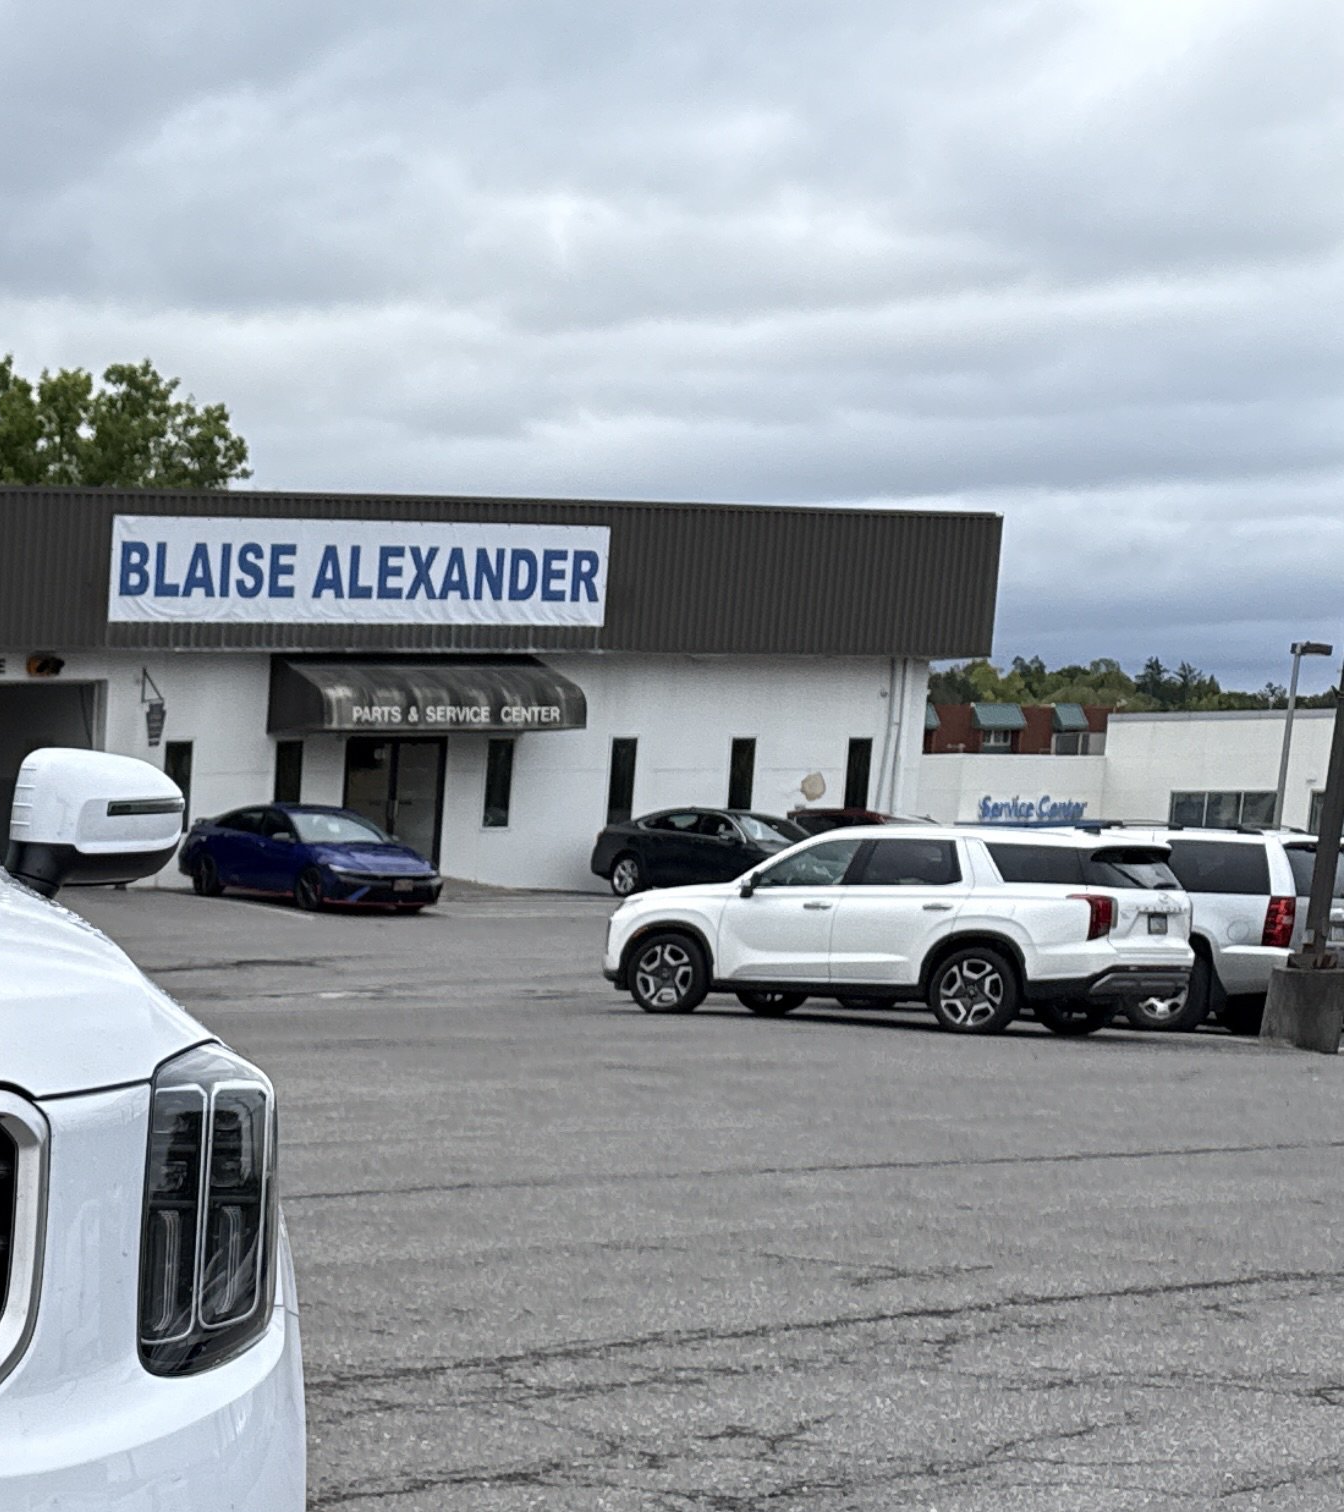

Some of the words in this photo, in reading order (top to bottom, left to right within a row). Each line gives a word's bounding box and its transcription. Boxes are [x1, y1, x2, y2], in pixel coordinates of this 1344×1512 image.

[118, 540, 298, 600] BLAISE
[311, 544, 600, 603] ALEXANDER
[351, 705, 402, 723] PARTS
[407, 706, 419, 723] &
[425, 705, 491, 723] SERVICE
[500, 705, 561, 723] CENTER
[977, 795, 1034, 819] Service
[1036, 795, 1088, 819] Center
